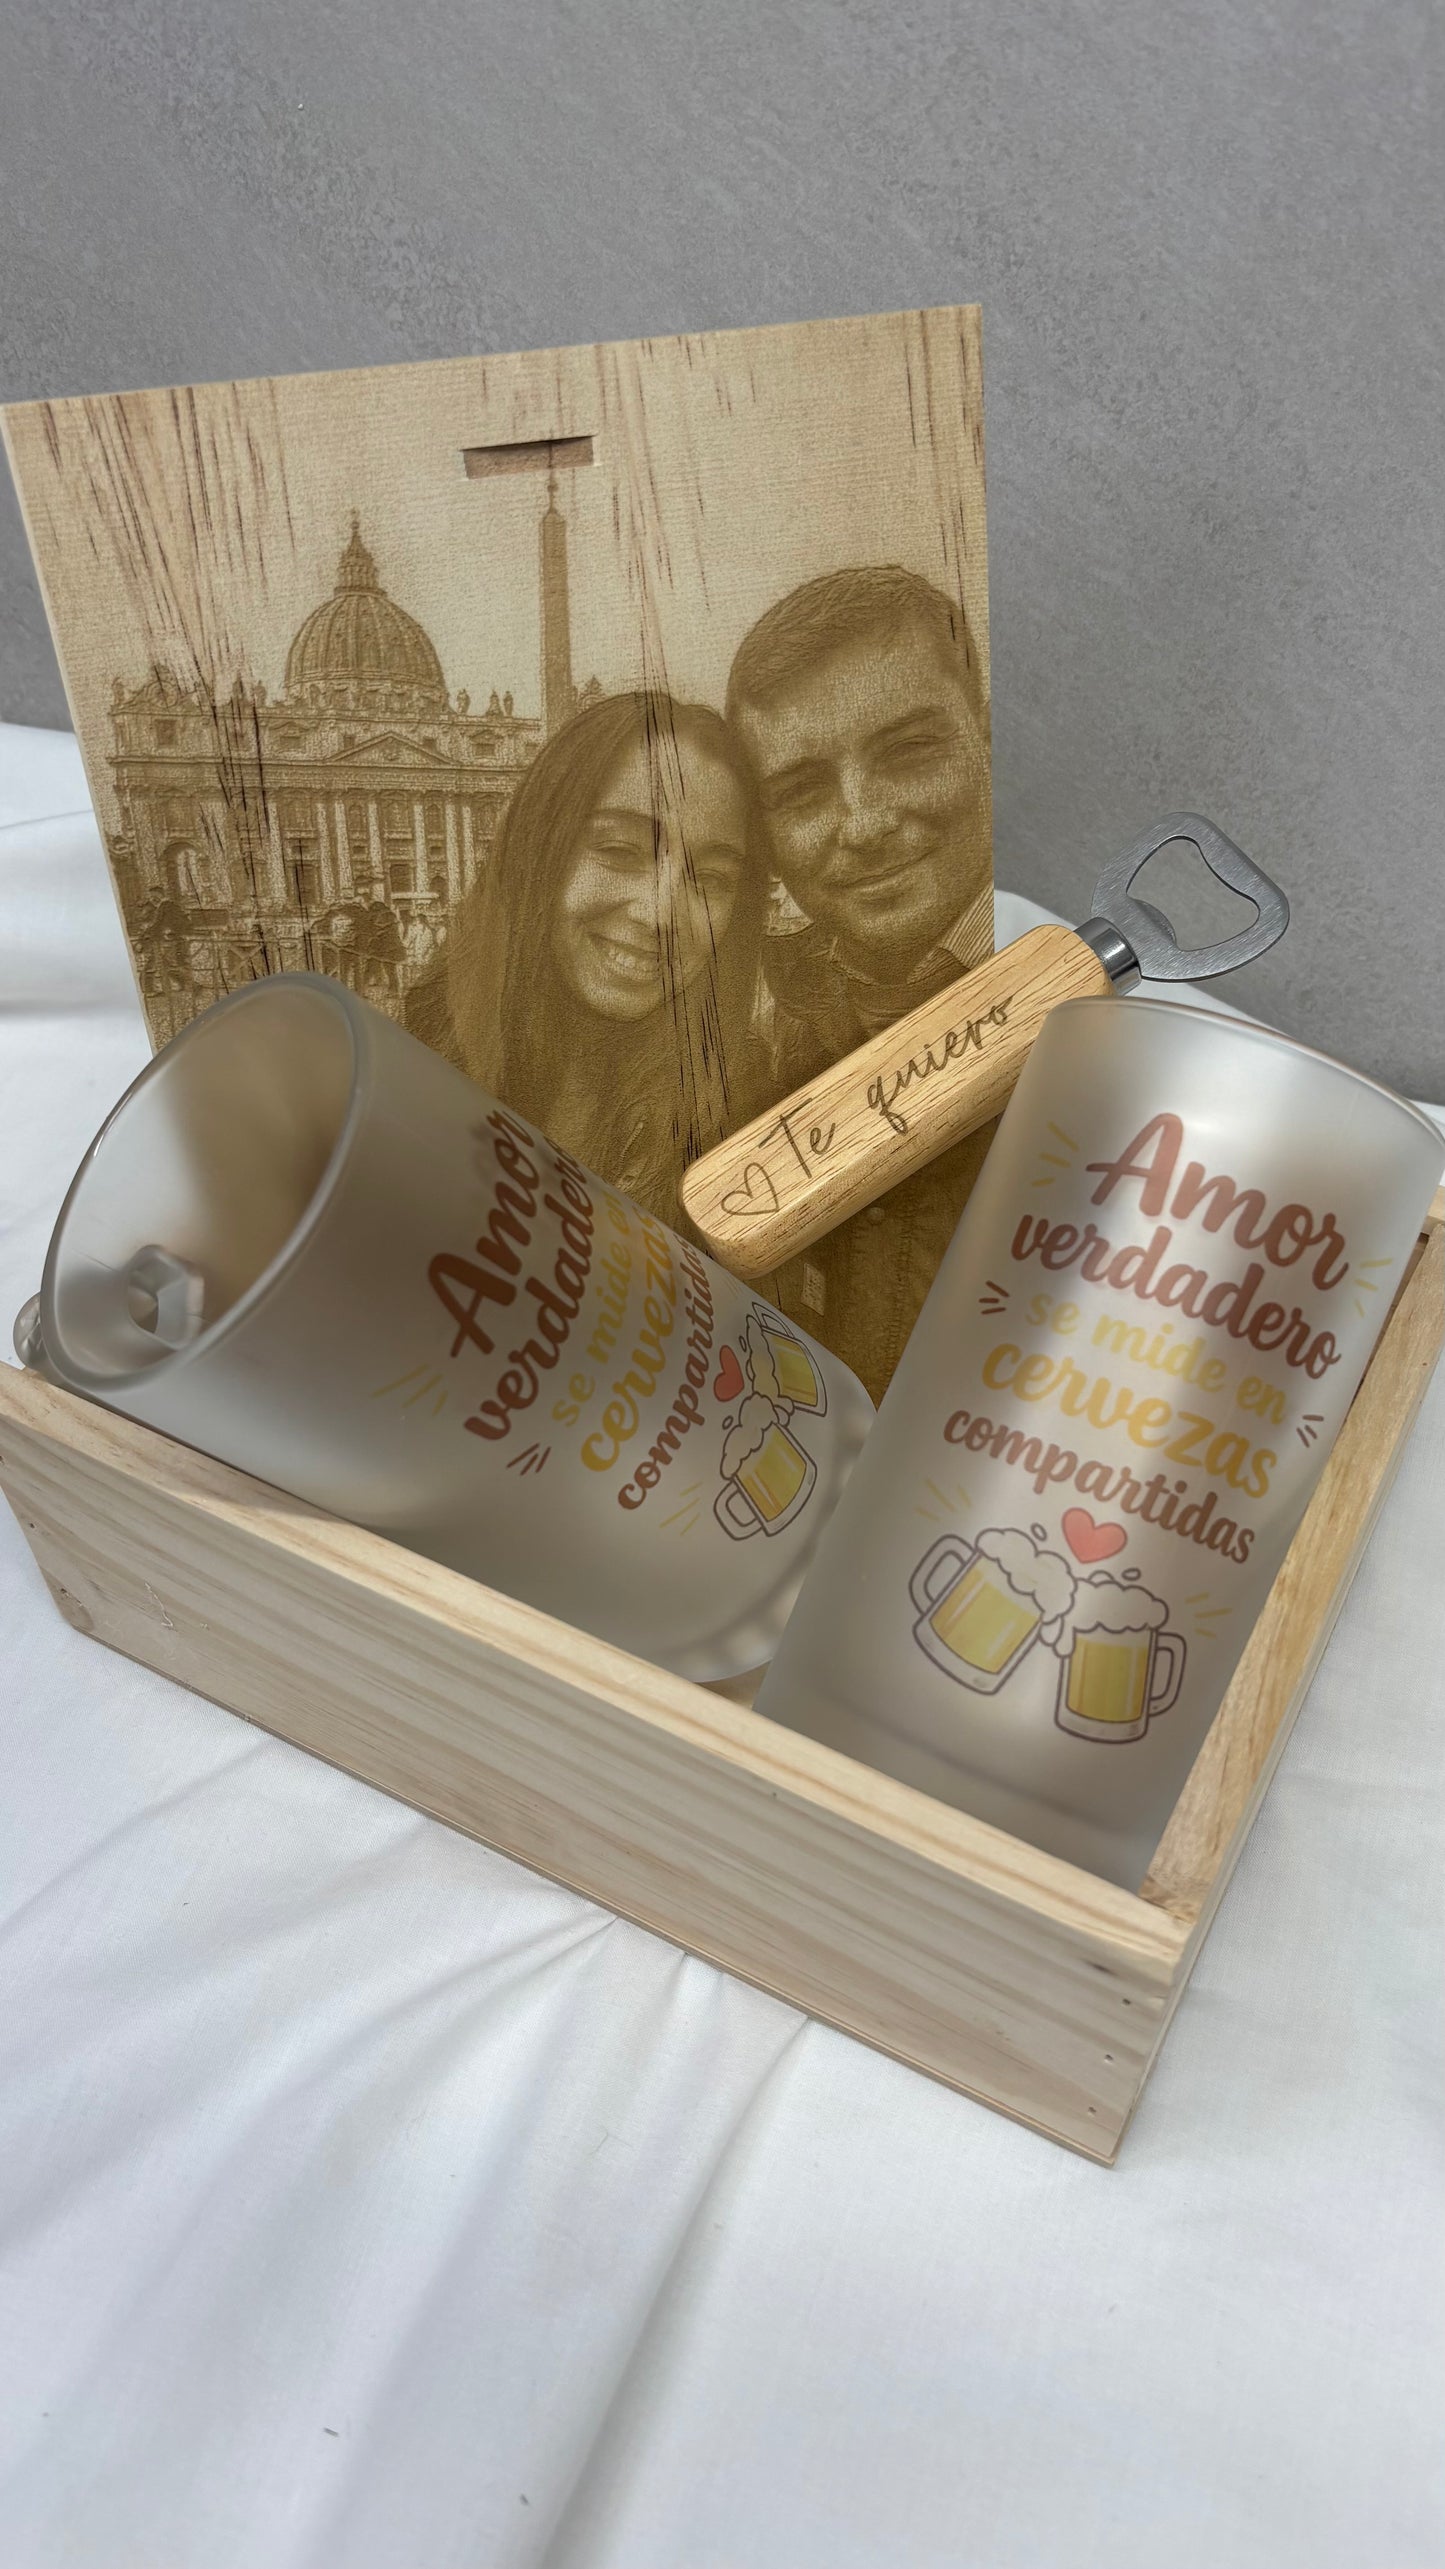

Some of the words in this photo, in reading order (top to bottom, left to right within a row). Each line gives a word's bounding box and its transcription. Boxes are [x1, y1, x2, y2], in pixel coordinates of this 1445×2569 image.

[758, 1097, 836, 1179] Te
[867, 995, 1013, 1136] quiero
[427, 1110, 540, 1358] Amor
[1085, 1112, 1349, 1291] Amor
[552, 1373, 596, 1427] se
[585, 1241, 632, 1365] mide
[581, 1205, 677, 1473] cervezas
[617, 1233, 715, 1510] compartidas
[1011, 1214, 1342, 1379] verdadero
[1024, 1292, 1079, 1335] se
[1092, 1314, 1226, 1394] mide
[1236, 1378, 1288, 1426] en
[943, 1409, 1256, 1564] compartidas
[981, 1343, 1278, 1499] cervezas
